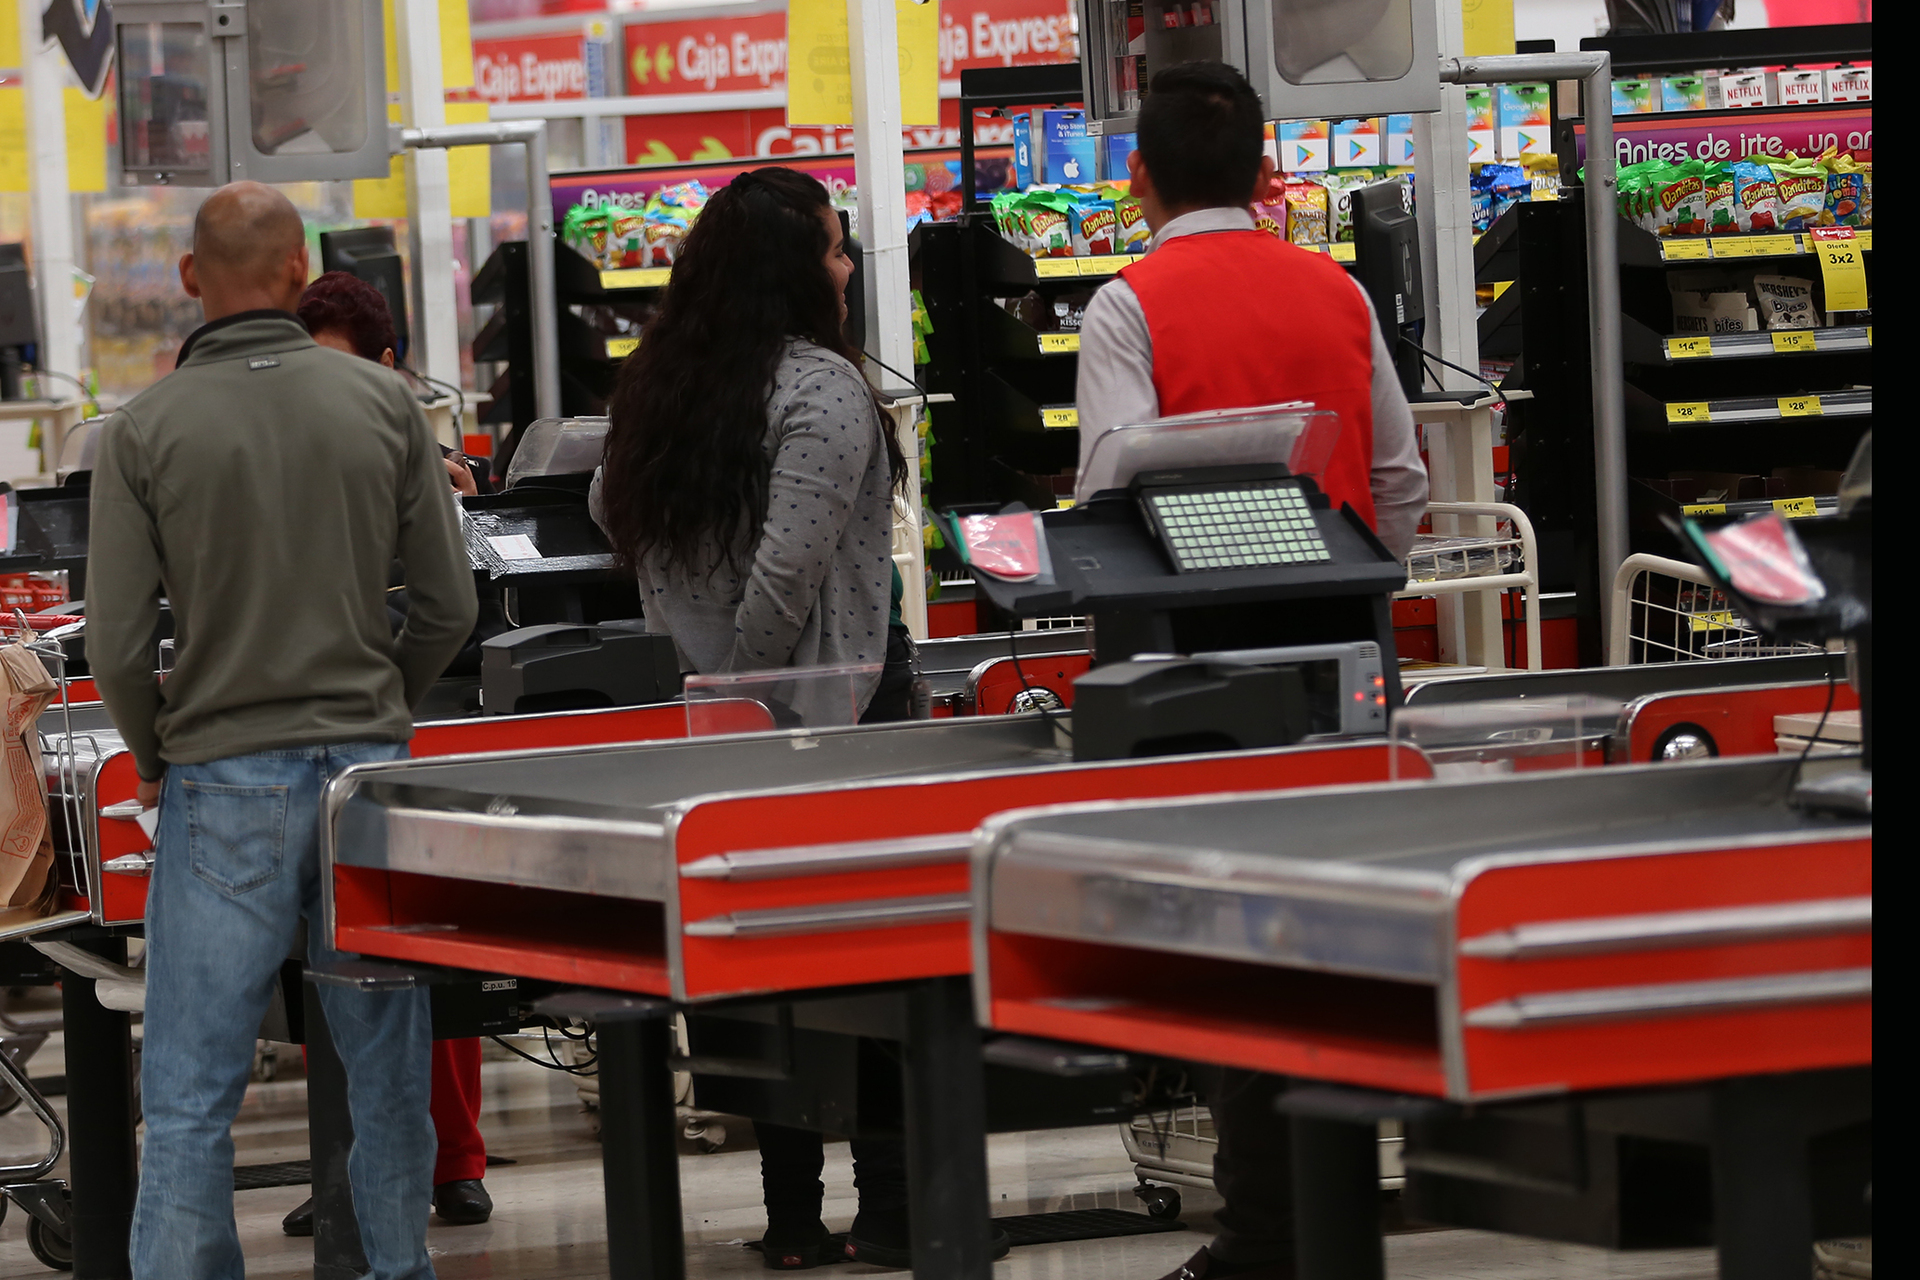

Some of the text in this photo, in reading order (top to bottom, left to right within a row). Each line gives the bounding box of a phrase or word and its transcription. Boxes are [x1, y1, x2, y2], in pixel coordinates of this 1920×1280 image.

[678, 33, 730, 90] Caja
[476, 52, 519, 103] Caja
[1727, 85, 1762, 100] NETFLIX
[1785, 83, 1818, 97] NETFLIX
[1832, 79, 1869, 93] NETFLIX
[1503, 101, 1548, 112] Google Play
[1056, 123, 1069, 131] App
[1070, 122, 1085, 130] Store
[1615, 137, 1688, 164] Antes
[1696, 133, 1731, 159] de
[1662, 180, 1700, 208] Panditas
[1780, 178, 1822, 202] Panditas
[582, 188, 645, 209] Antes
[1829, 253, 1855, 265] 3x2
[1714, 317, 1743, 333] bites
[482, 980, 516, 991] C.p.u. 19
